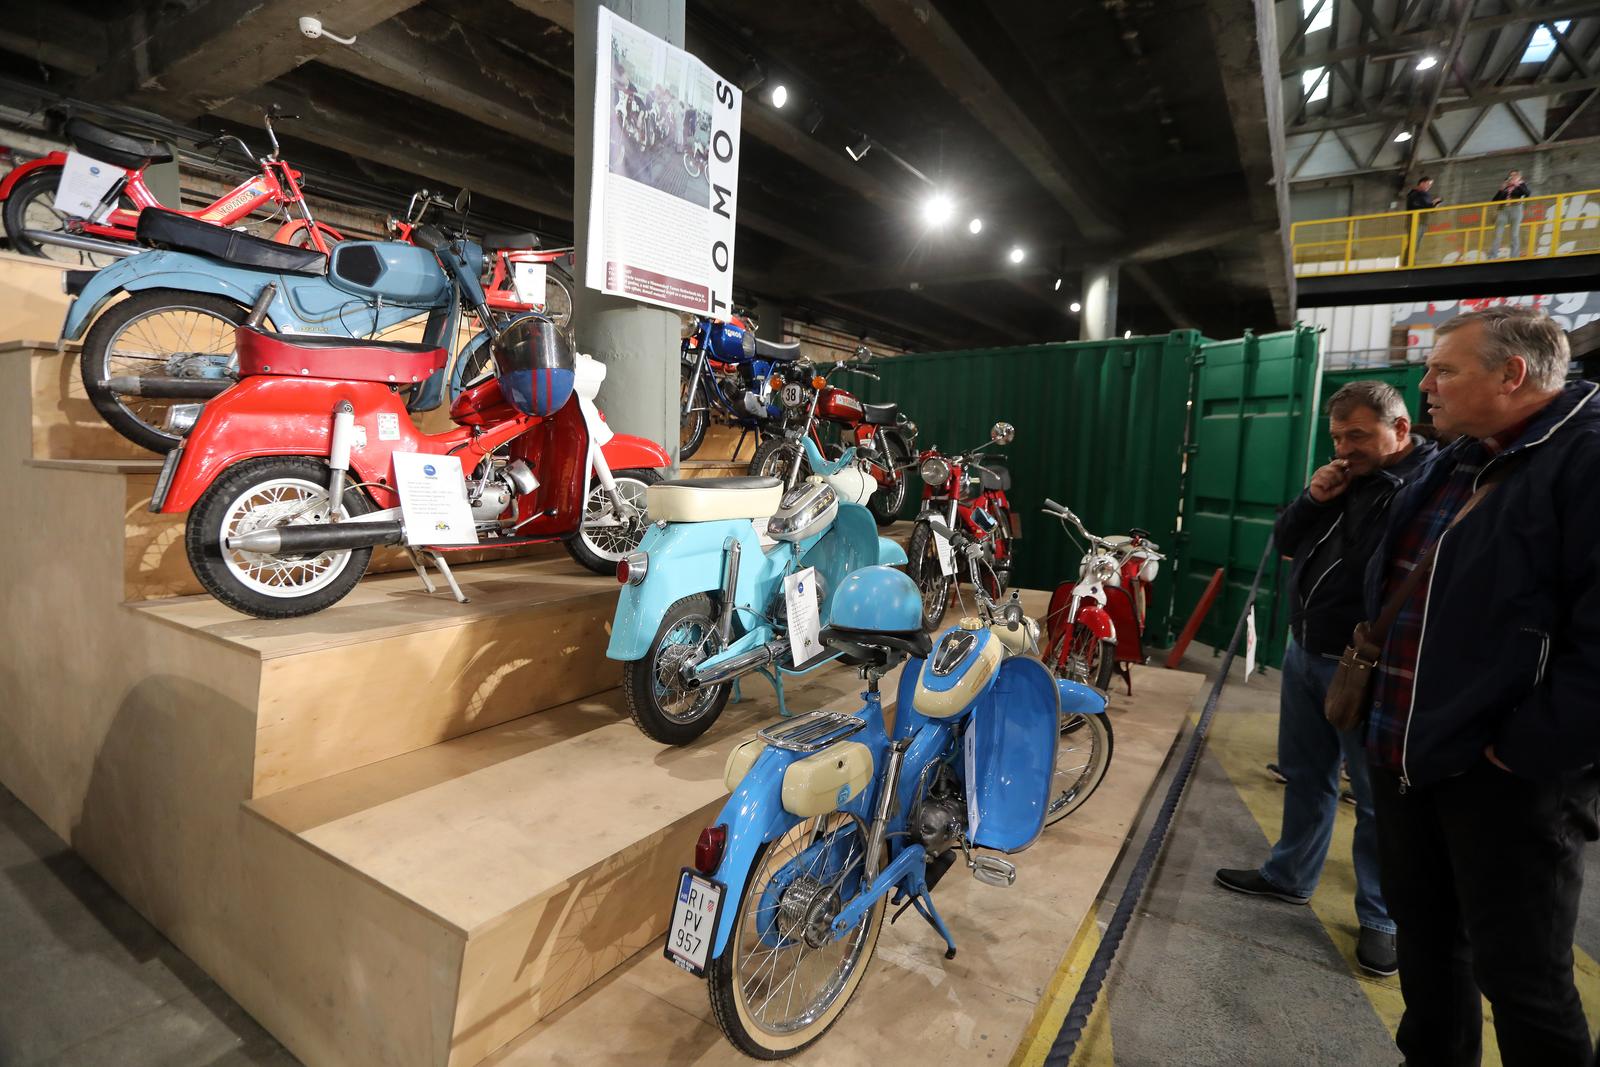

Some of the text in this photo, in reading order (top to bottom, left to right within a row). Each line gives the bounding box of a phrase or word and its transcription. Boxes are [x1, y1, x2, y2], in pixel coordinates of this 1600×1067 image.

[221, 190, 253, 215] TOMOS
[711, 80, 734, 313] TOMOS
[785, 387, 796, 401] 38
[688, 888, 704, 911] RI
[684, 909, 702, 932] PV
[676, 928, 701, 954] 957
